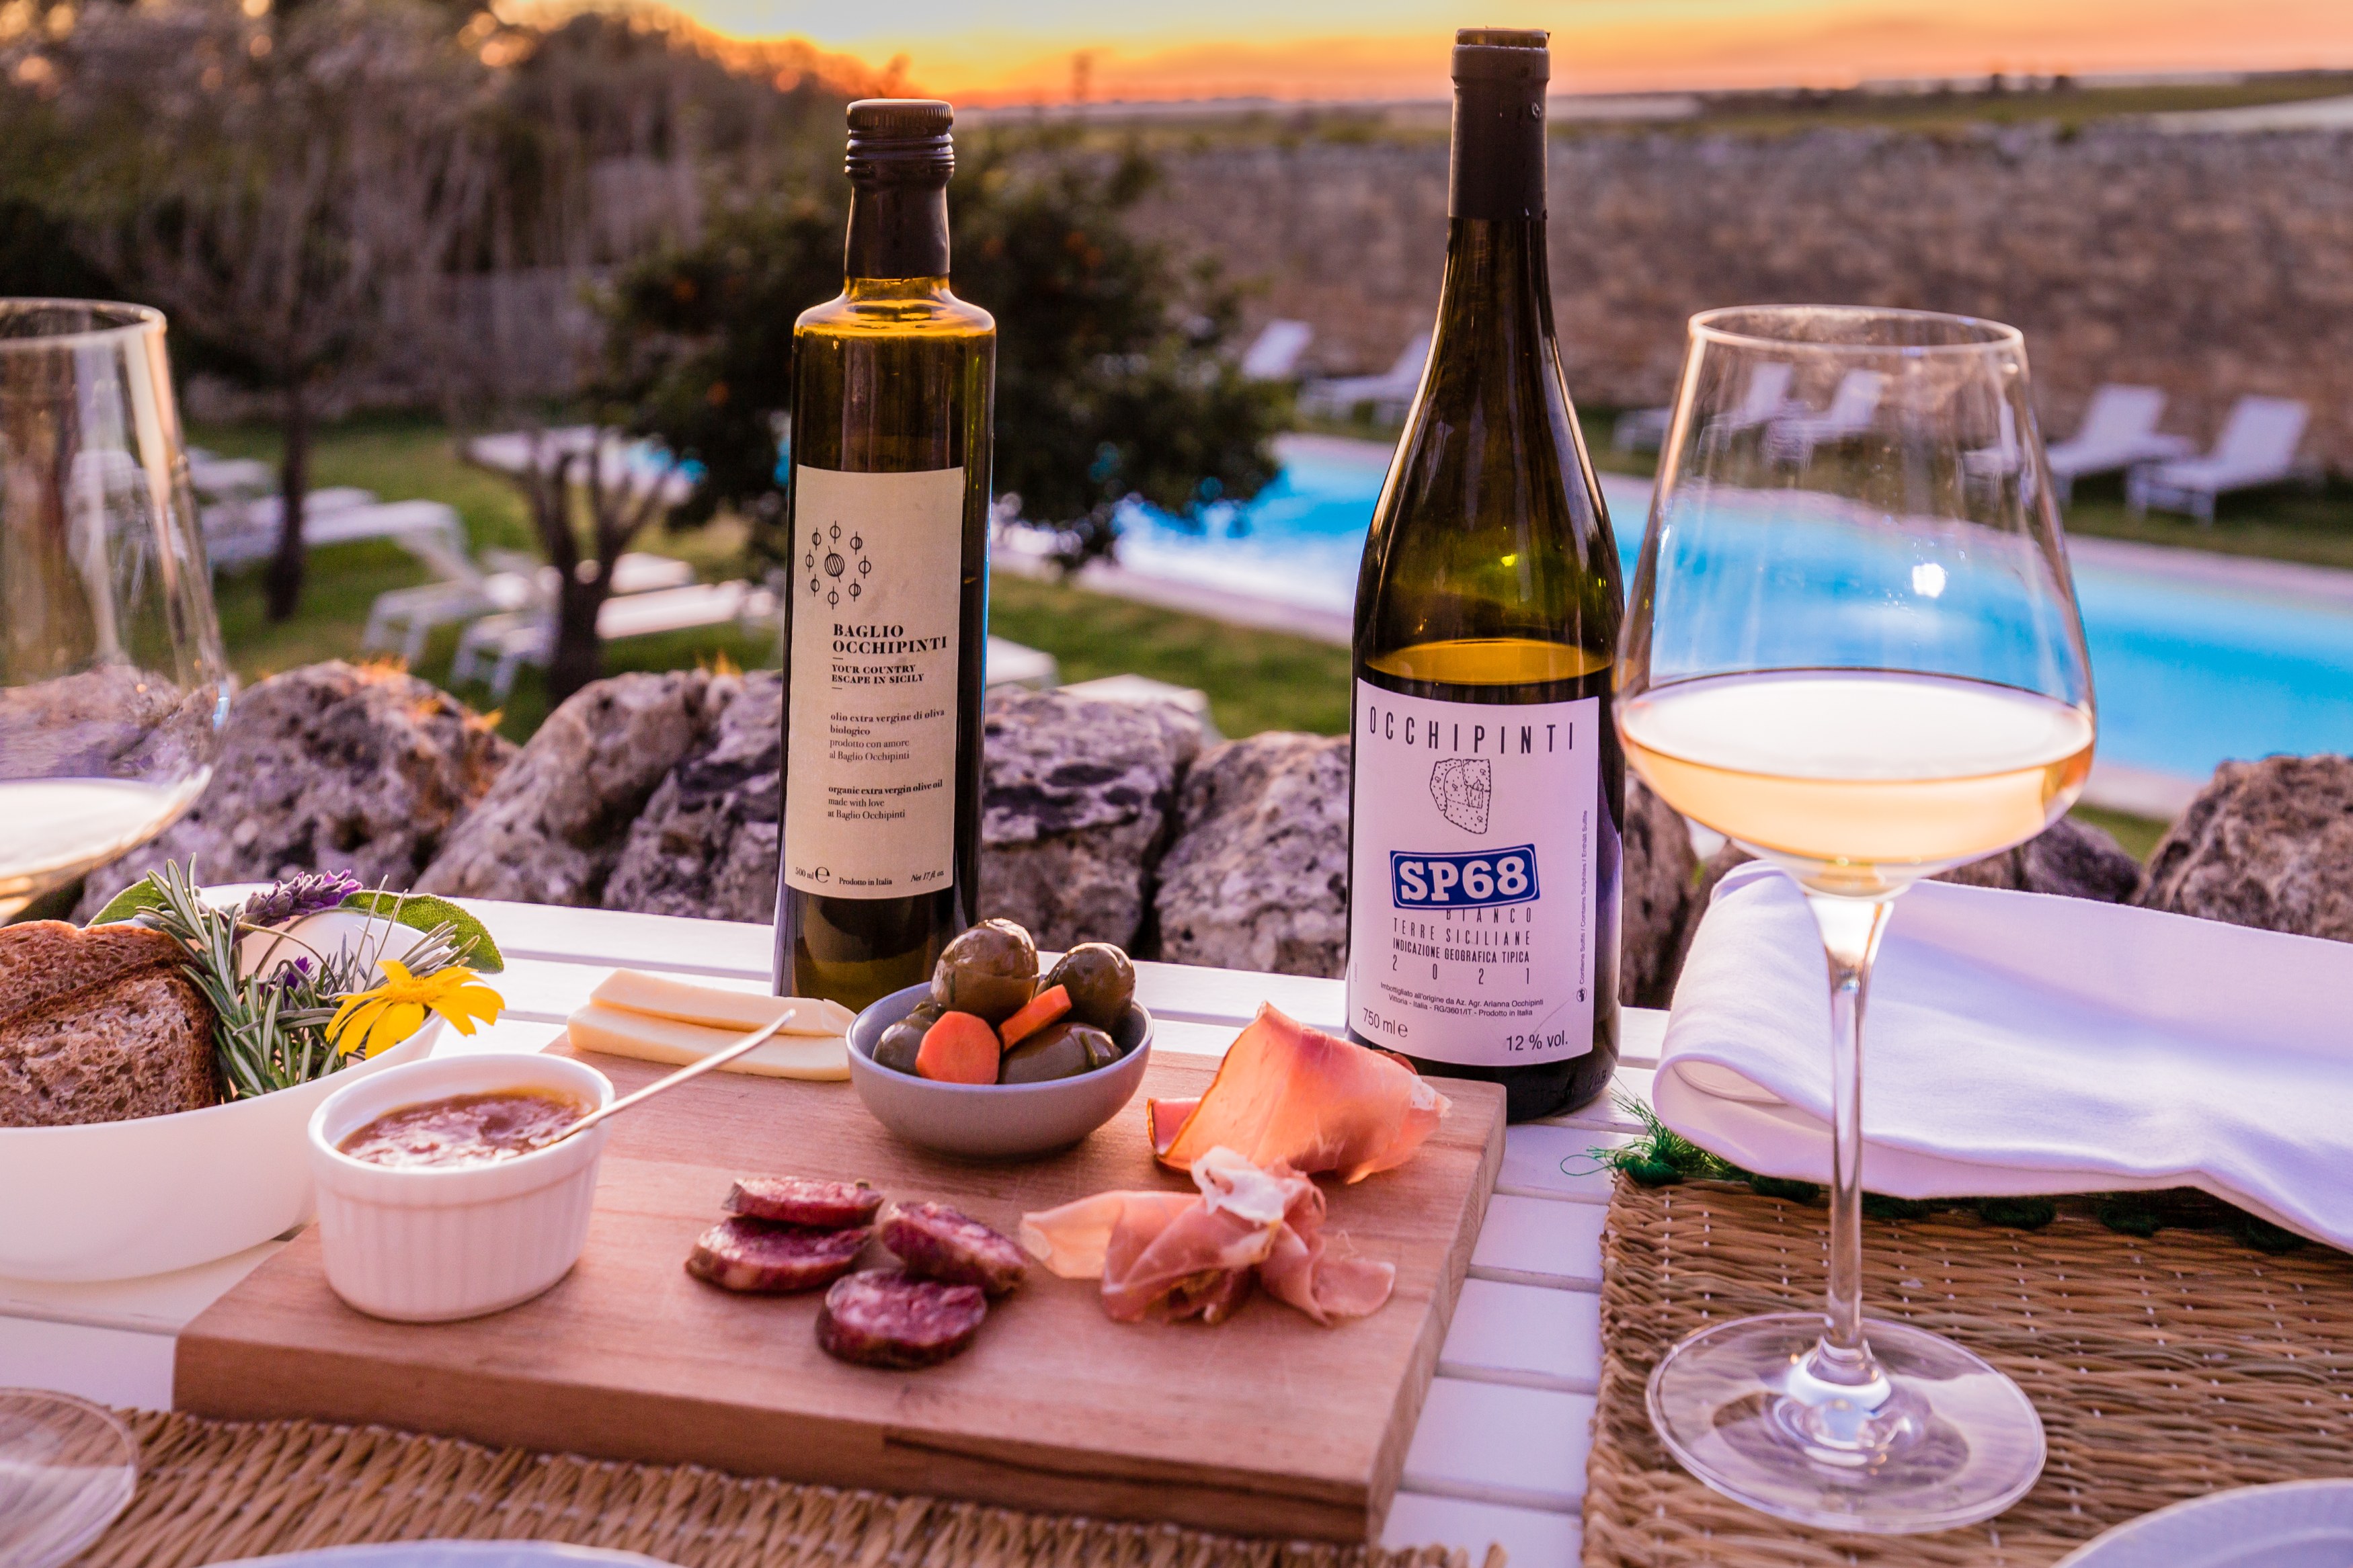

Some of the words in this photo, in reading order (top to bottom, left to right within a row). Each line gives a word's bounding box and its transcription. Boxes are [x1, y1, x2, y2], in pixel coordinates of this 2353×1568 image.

[834, 623, 904, 638] BAGLIO
[832, 636, 947, 654] OCCHIPINTI
[832, 664, 860, 673] YOUR
[863, 664, 916, 674] COUNTRY
[832, 674, 871, 684] ESCAPE
[874, 676, 885, 684] IN
[889, 673, 924, 684] SICILY
[830, 712, 848, 721] olio
[850, 714, 873, 723] extra
[876, 712, 912, 725] vergine
[914, 711, 922, 720] di
[924, 709, 945, 718] oliva
[830, 725, 871, 737] biologico
[1369, 706, 1573, 754] OCCHIPINTI
[830, 739, 864, 748] prodotto
[883, 739, 910, 748] amore
[830, 751, 836, 759] al
[838, 751, 863, 763] Baglio
[865, 751, 910, 763] Occhipinti
[828, 786, 860, 796] organic
[885, 785, 911, 796] vergin
[913, 782, 932, 792] olive
[932, 779, 943, 788] oil
[828, 798, 848, 806] made
[850, 798, 867, 807] with
[869, 798, 885, 807] love
[836, 809, 861, 821] Baglio
[863, 809, 905, 821] Occhipinti
[795, 866, 806, 876] 500
[807, 871, 814, 880] ml
[910, 874, 921, 882] Net
[923, 872, 930, 880] 17
[1399, 855, 1529, 902] SP68
[839, 877, 867, 886] Prodotto
[868, 878, 875, 886] in
[876, 877, 893, 886] Italia
[1446, 907, 1531, 923] BIANCO
[1394, 917, 1435, 941] TERRE
[1446, 928, 1530, 946] SICILIANE
[1393, 938, 1440, 958] INDICAZIONE
[1445, 948, 1497, 963] GEOGRAFICA
[1502, 951, 1529, 963] TIPICA
[1380, 981, 1413, 997] Imbottigliato
[1414, 991, 1444, 1004] all'origine
[1455, 998, 1467, 1006] Az.
[1468, 999, 1482, 1008] Agr.
[1483, 999, 1510, 1007] Arianna
[1511, 998, 1544, 1008] Occhipinti
[1388, 993, 1408, 1005] Vittoria
[1413, 1001, 1428, 1009] Italia
[1478, 1009, 1507, 1017] Prodotto
[1363, 1007, 1380, 1029] 750
[1383, 1019, 1396, 1036] ml
[1506, 1035, 1525, 1052] 12
[1529, 1034, 1542, 1050] %
[1546, 1030, 1568, 1048] vol.
